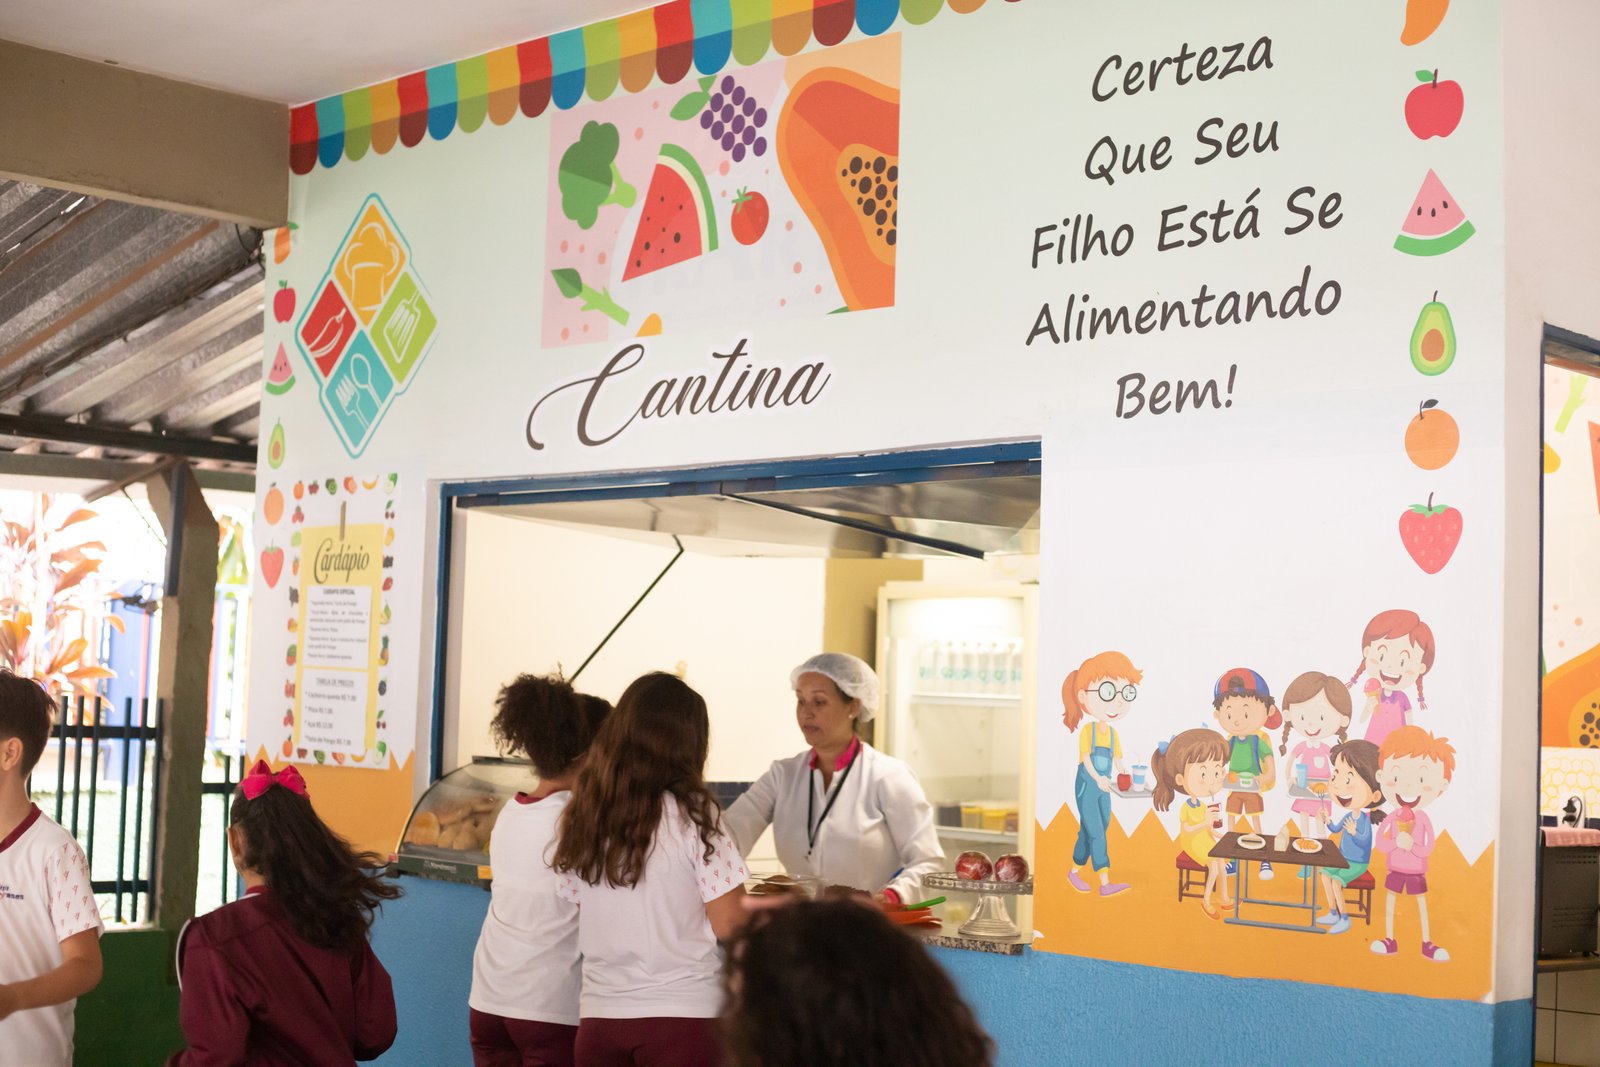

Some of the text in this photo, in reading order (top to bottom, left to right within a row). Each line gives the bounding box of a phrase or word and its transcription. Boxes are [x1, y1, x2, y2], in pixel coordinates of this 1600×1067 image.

[1091, 36, 1274, 103] Certeza
[1084, 117, 1280, 186] Que Seu
[1032, 185, 1344, 269] Filho Está Se
[1025, 265, 1342, 347] Alimentando
[526, 339, 832, 450] Cantina
[1115, 363, 1238, 420] Bem!
[314, 537, 370, 584] Cardápio
